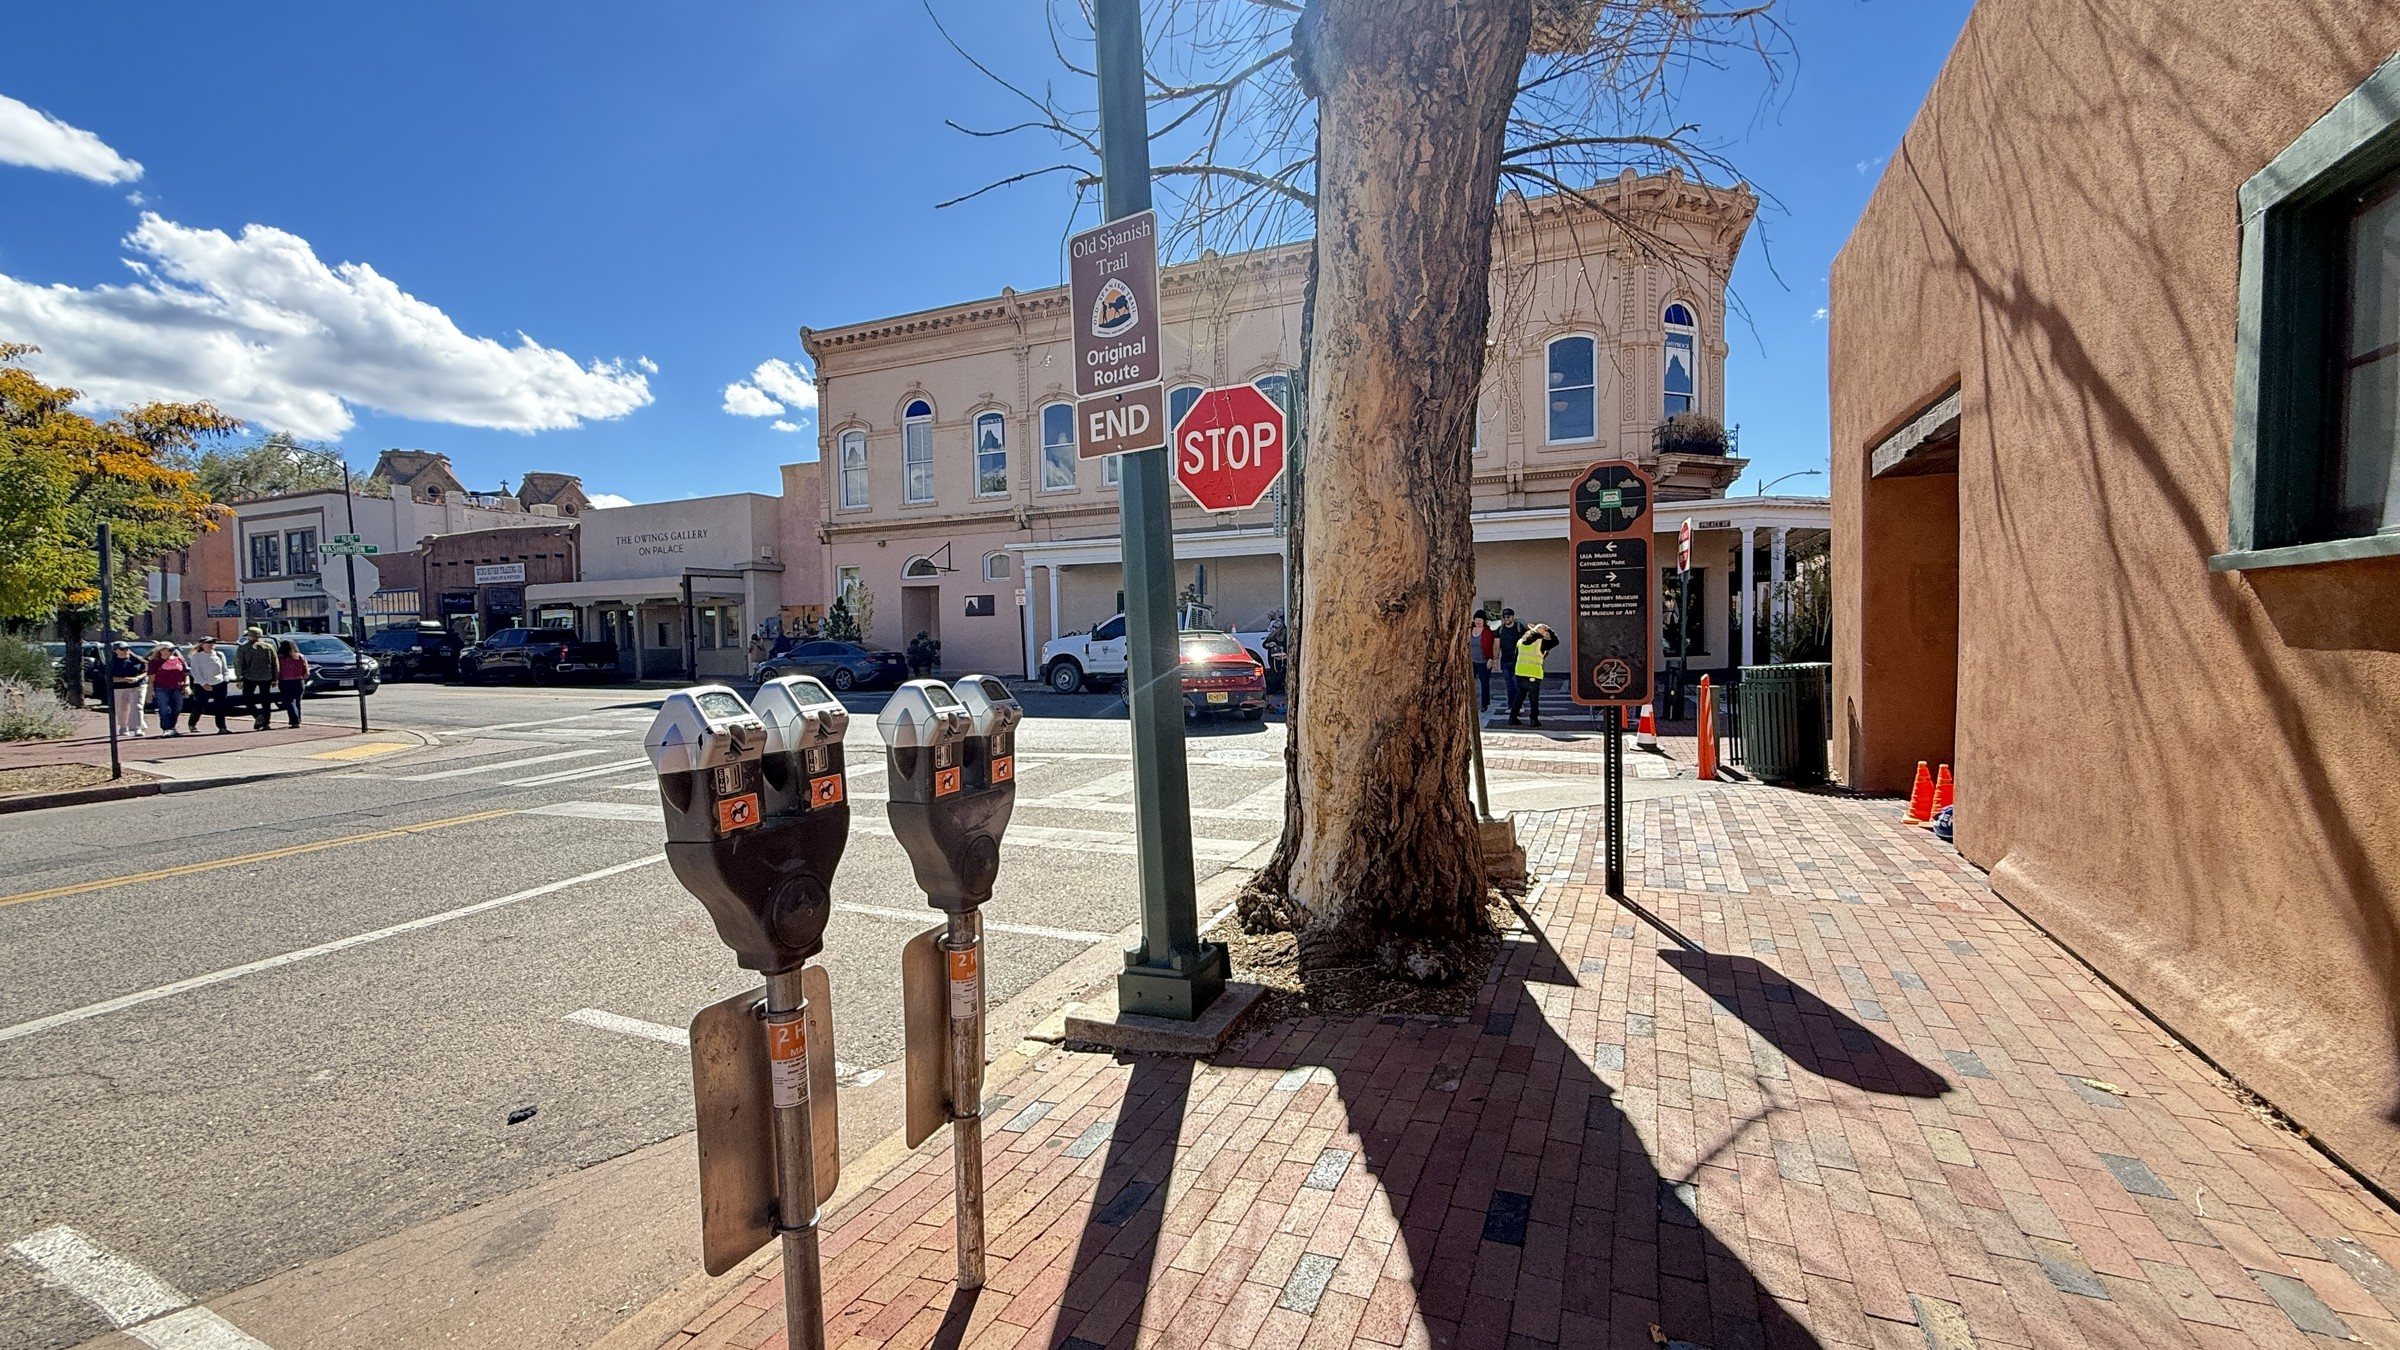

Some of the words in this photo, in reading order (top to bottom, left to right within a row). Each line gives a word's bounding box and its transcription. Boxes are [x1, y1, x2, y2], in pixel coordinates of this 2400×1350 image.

[1073, 236, 1097, 258] Old
[1099, 220, 1151, 253] Spanish
[1096, 251, 1129, 276] Trail
[1099, 283, 1126, 301] SPANISH
[1126, 291, 1136, 314] TRAIL
[1087, 336, 1147, 366] Original
[1094, 364, 1140, 387] Route
[1090, 404, 1150, 443] END
[1183, 421, 1277, 475] STOP
[321, 545, 364, 553] WASHINGTON
[616, 536, 632, 545] THE
[634, 533, 668, 543] OWINGS
[670, 529, 708, 540] GALLERY
[639, 547, 651, 556] ON
[653, 544, 684, 554] PALACE
[718, 769, 727, 794] COINS
[958, 954, 967, 967] 2
[779, 1027, 790, 1043] 2
